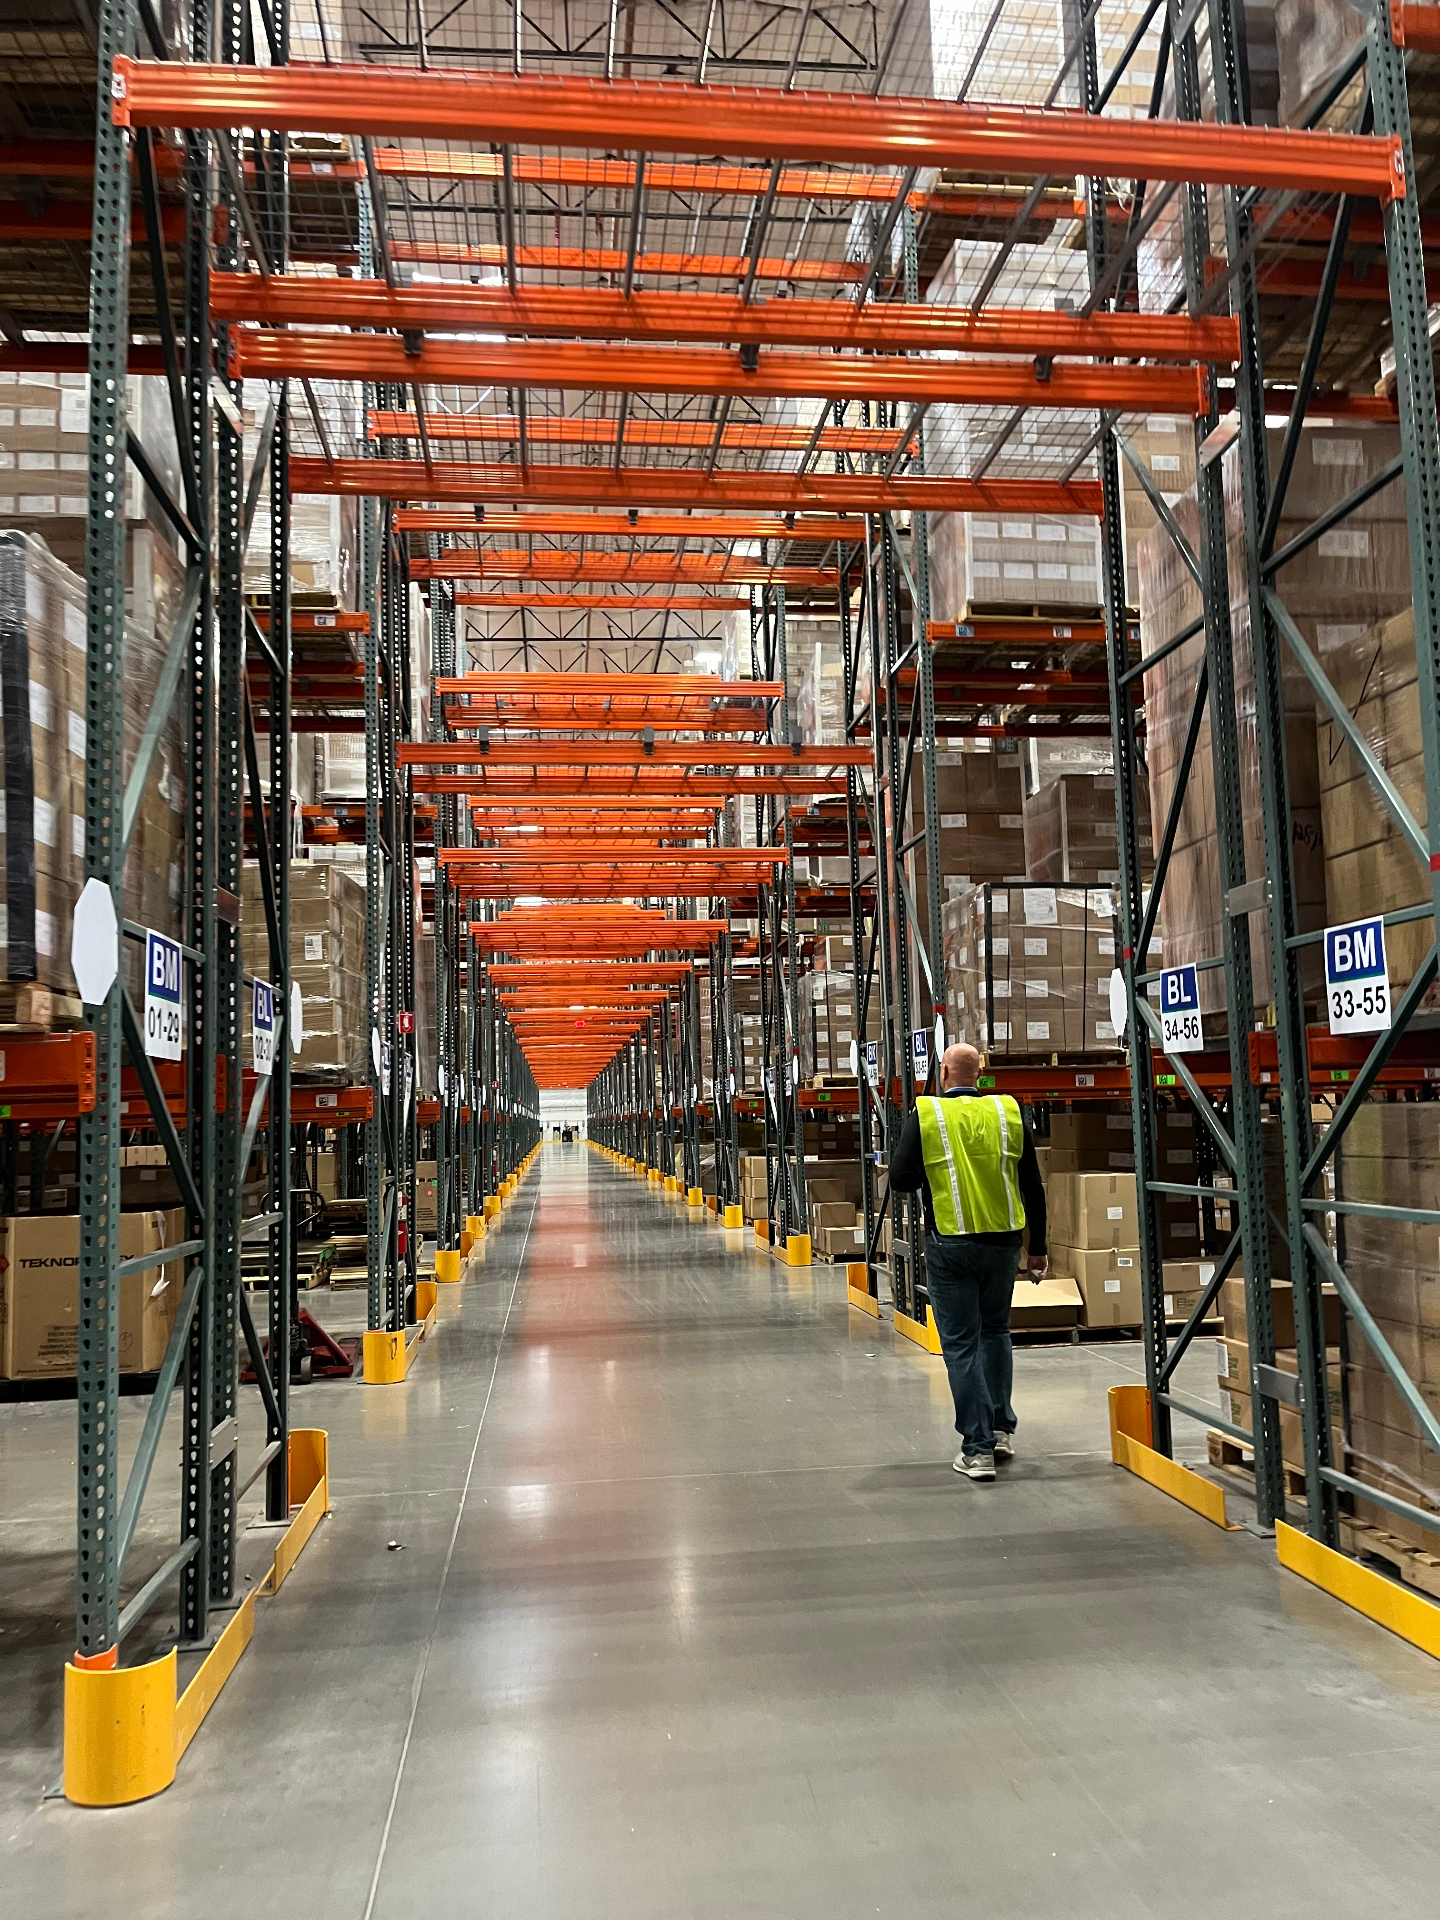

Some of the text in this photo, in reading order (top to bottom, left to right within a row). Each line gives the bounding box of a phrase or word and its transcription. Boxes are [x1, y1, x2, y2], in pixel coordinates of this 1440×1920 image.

[152, 942, 178, 992] BM
[1333, 927, 1377, 973] BM
[257, 987, 271, 1023] BL
[1167, 973, 1192, 1006] BL
[1331, 985, 1387, 1019] 33-55
[149, 1006, 180, 1044] 01-29
[1164, 1016, 1200, 1042] 34-56
[916, 1034, 925, 1052] BL
